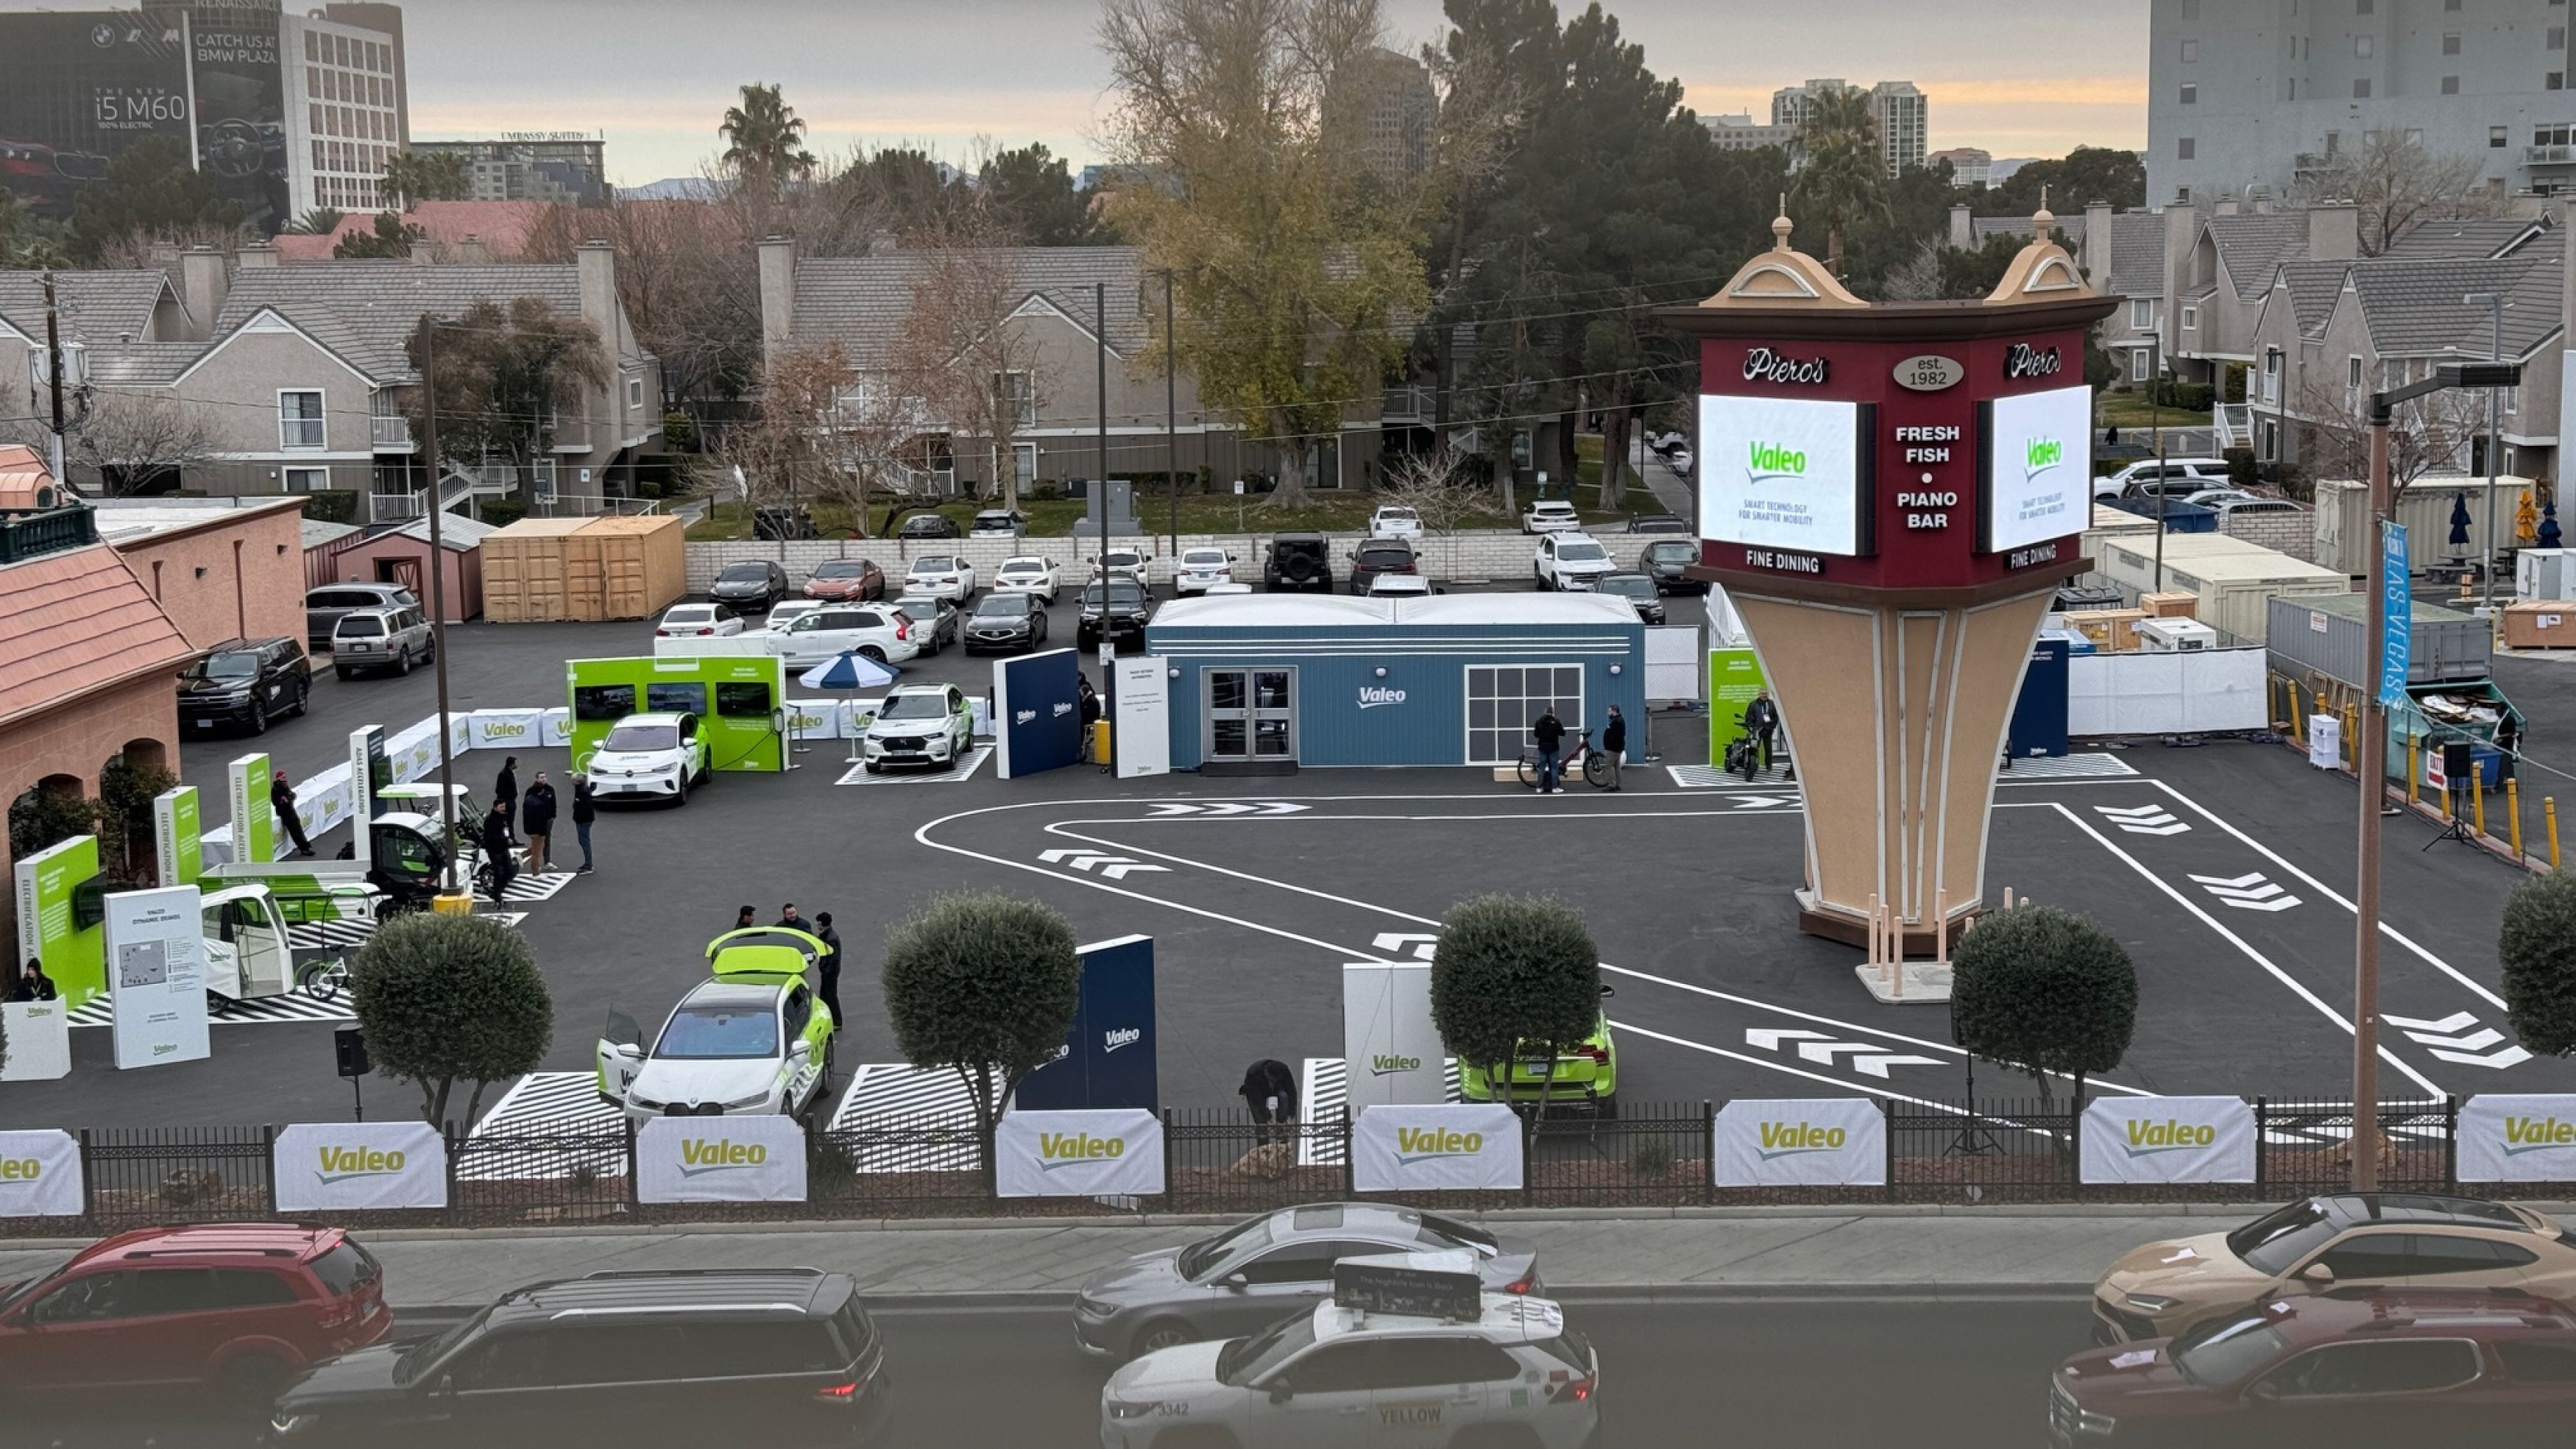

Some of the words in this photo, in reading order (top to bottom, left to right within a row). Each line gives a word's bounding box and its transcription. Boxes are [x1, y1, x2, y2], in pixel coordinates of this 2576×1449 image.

[197, 34, 244, 47] CATCH
[247, 35, 263, 48] US
[266, 36, 275, 48] AT
[198, 49, 235, 62] BMW
[238, 49, 277, 63] PLAZA
[96, 96, 118, 121] i5
[127, 96, 185, 121] M60
[120, 121, 154, 130] ELECTRIC
[501, 132, 545, 140] EMBASSY
[1744, 348, 1824, 383] Piero's
[1917, 357, 1942, 370] est.
[2011, 343, 2062, 378] Piero's
[1910, 371, 1947, 385] 1982
[1896, 426, 1959, 442] FRESH
[1750, 441, 1806, 473] Valeo
[1906, 447, 1950, 463] FISH
[2026, 436, 2062, 467] Valeo
[1897, 491, 1958, 507] PIANO
[1907, 513, 1948, 528] BAR
[1747, 549, 1773, 567] FINE
[1777, 553, 1819, 573] DINING
[2011, 550, 2028, 570] FINE
[2031, 542, 2056, 564] DINING
[2388, 557, 2406, 604] LAS
[2385, 614, 2407, 695] VEGAS
[1359, 687, 1406, 702] Valeo
[484, 723, 526, 736] Valeo
[237, 835, 247, 862] ACCELER
[23, 879, 35, 946] ELECTRIFICATION
[1105, 1028, 1140, 1046] Valeo
[1373, 1055, 1420, 1070] Valeo
[1397, 1127, 1483, 1154] Valeo
[1760, 1121, 1846, 1149] Valeo
[2126, 1118, 2215, 1147] Valeo
[2505, 1116, 2576, 1143] Vale
[682, 1138, 766, 1165] Valeo
[1040, 1131, 1125, 1159] Valeo
[319, 1146, 406, 1172] Valeo
[1158, 1403, 1189, 1417] 3342
[1379, 1406, 1441, 1425] YELLOW
